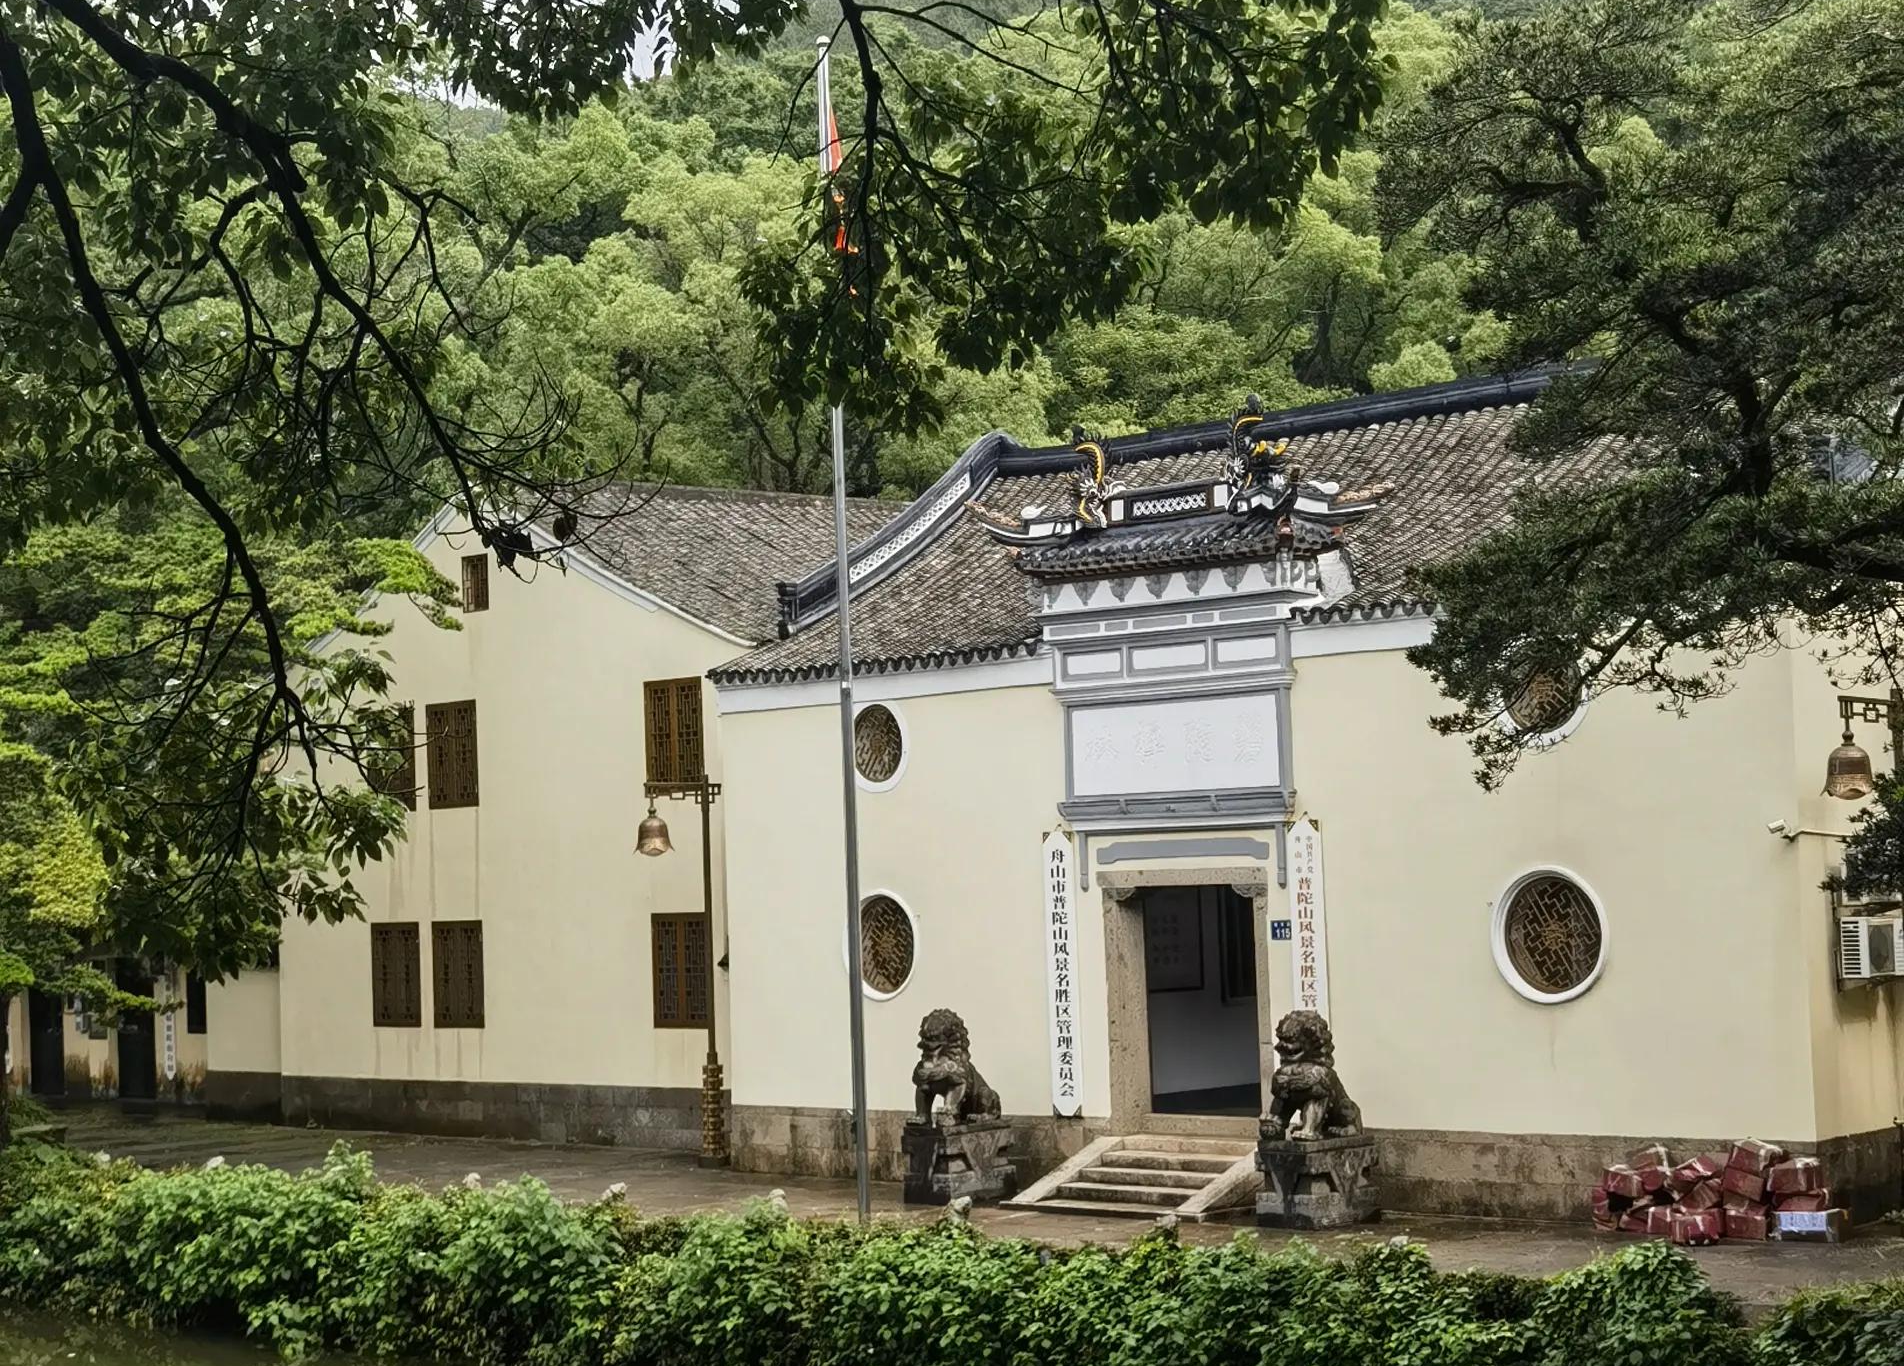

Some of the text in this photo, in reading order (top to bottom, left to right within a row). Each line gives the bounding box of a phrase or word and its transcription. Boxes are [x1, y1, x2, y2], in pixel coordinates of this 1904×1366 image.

[1050, 848, 1075, 1098] 舟山市普陀山风景名胜区管理委员会
[1296, 876, 1318, 1012] 普陀山风景名胜区管
